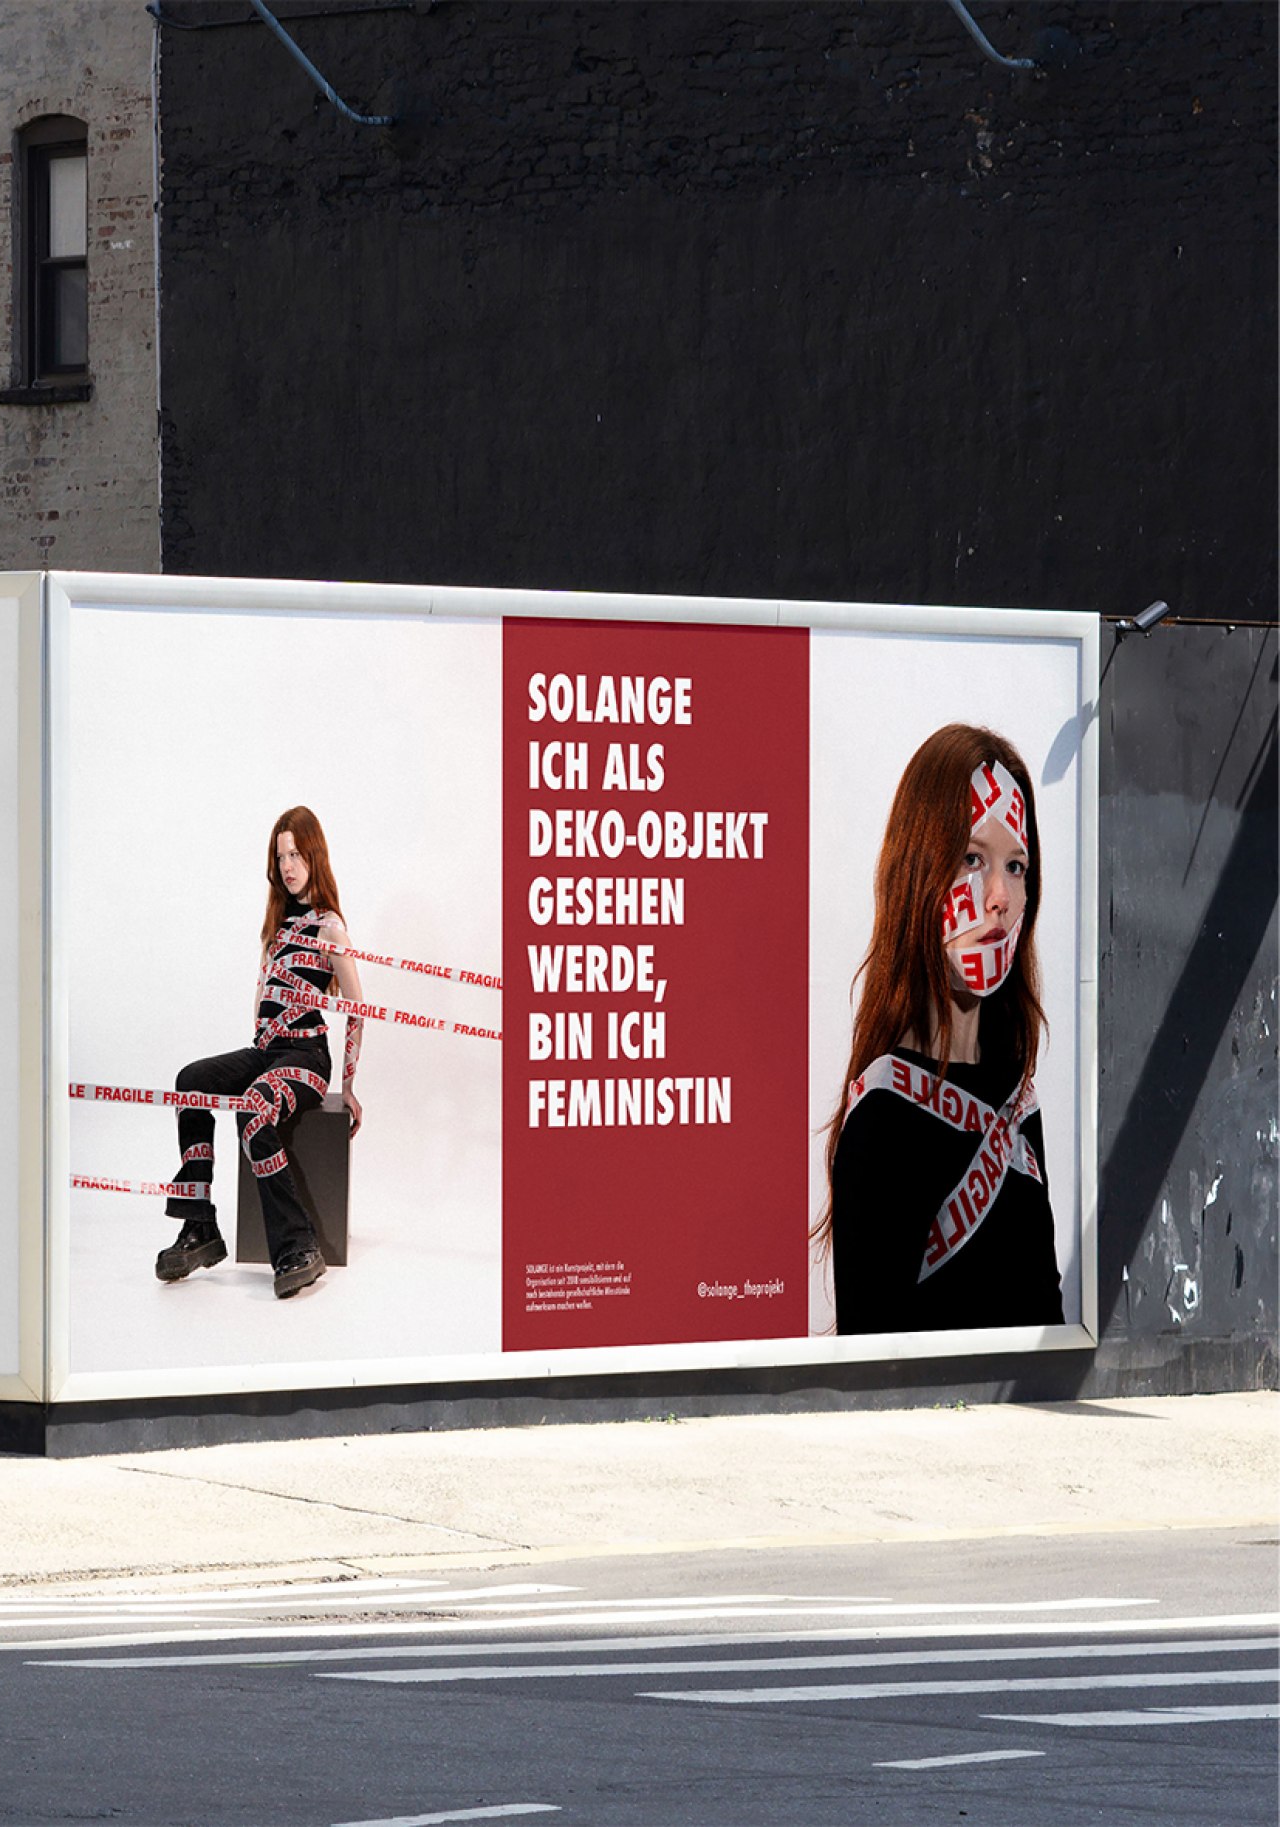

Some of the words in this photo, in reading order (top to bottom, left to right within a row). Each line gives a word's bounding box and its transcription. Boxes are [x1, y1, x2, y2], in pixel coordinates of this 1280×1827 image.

[529, 673, 692, 724] SOLANGE
[529, 741, 588, 790] ICH
[602, 743, 665, 792] ALS
[529, 809, 769, 860] DEKO-OBJEKT
[528, 877, 685, 926] GESEHEN
[343, 947, 394, 966] FRAGILE
[400, 959, 453, 979] FRAGILE
[528, 945, 668, 1003] WERDE,
[280, 989, 329, 1009] FRAGILE
[335, 1000, 387, 1021] FRAGILE
[394, 1010, 446, 1031] FRAGILE
[529, 1012, 592, 1061] BIN
[608, 1011, 666, 1060] ICH
[95, 1086, 154, 1104] FRAGILE
[163, 1092, 220, 1109] FRAGILE
[529, 1077, 731, 1128] FEMINISTIN
[73, 1174, 131, 1192] FRAGILE
[140, 1181, 196, 1197] FRAGILE
[697, 1278, 784, 1300] @solange_theprojekt
